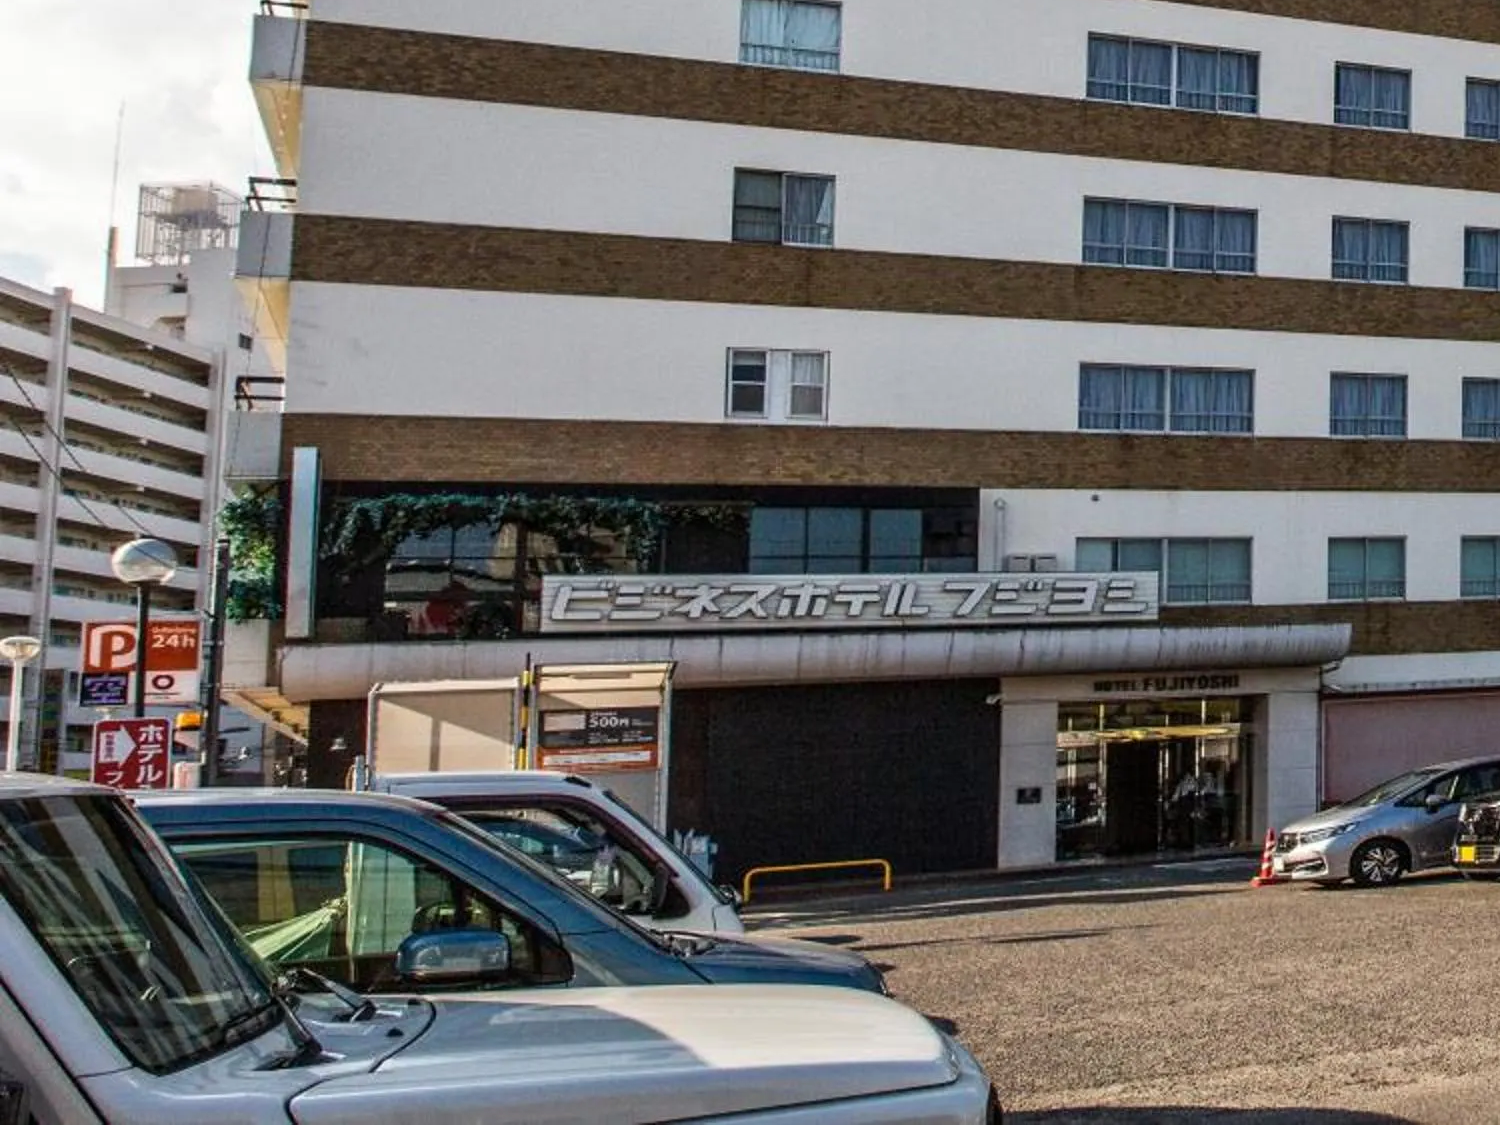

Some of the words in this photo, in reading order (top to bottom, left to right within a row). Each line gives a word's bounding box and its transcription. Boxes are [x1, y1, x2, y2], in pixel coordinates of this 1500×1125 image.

[151, 634, 196, 649] 24h
[1142, 674, 1240, 691] FUJIYOSHI
[136, 724, 164, 789] ホテル
